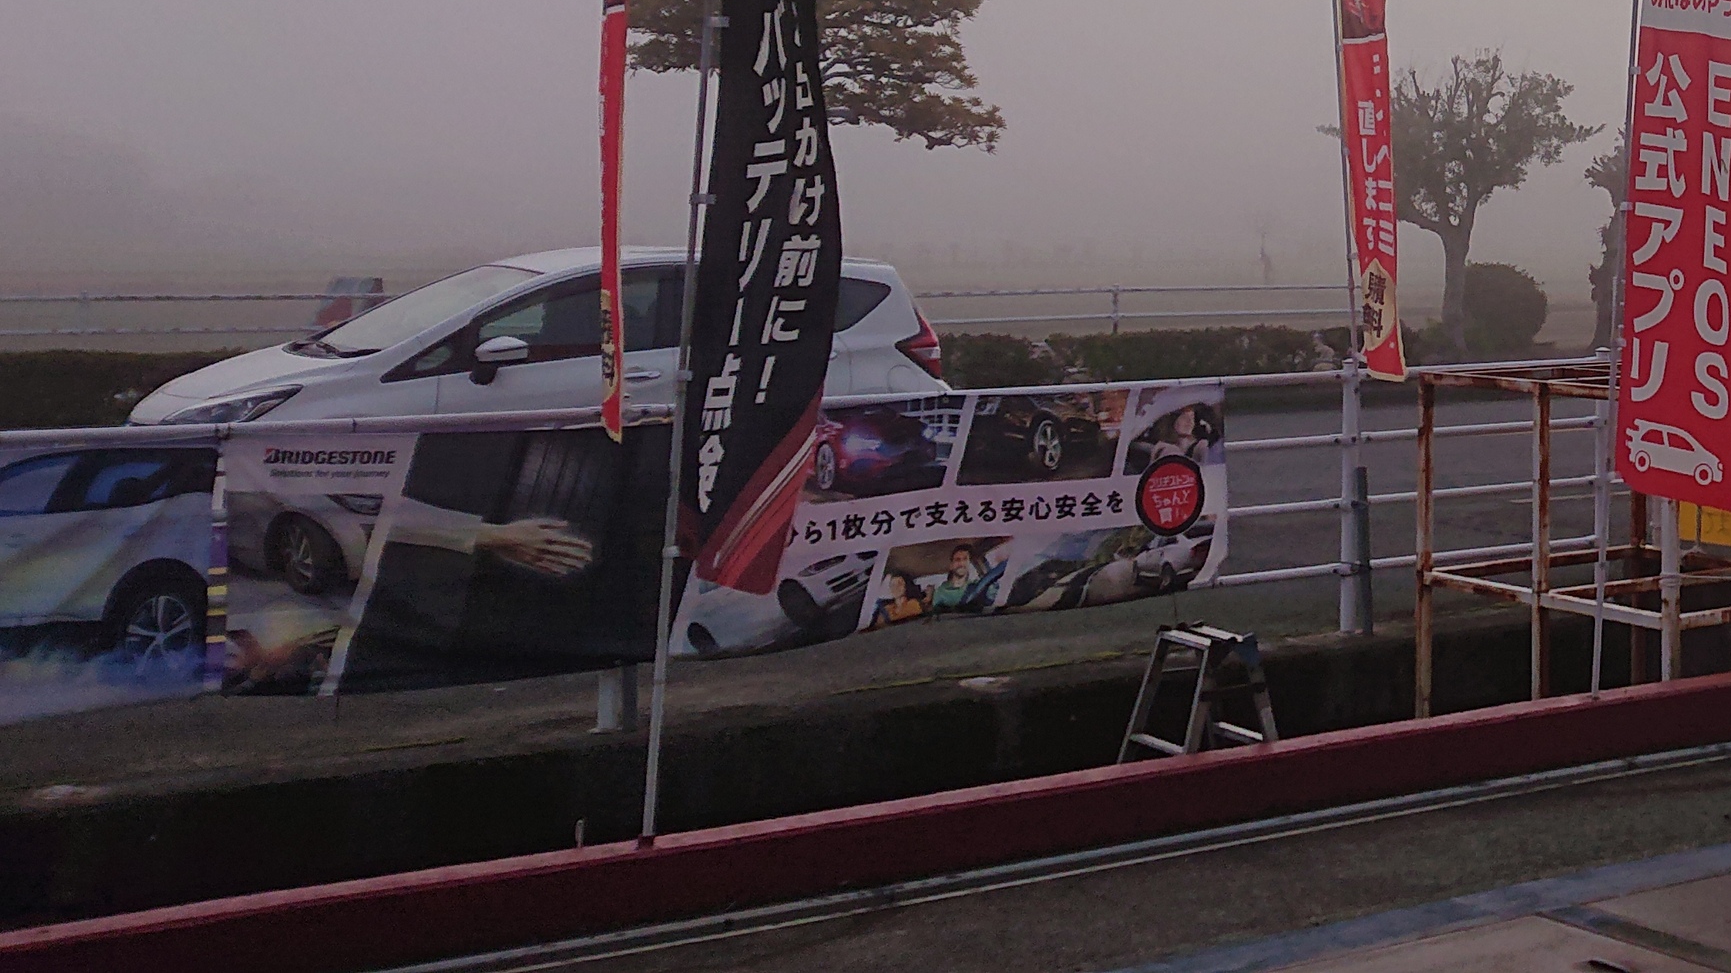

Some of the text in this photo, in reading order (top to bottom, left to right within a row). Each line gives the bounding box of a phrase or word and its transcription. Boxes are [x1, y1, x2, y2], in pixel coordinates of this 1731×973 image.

[755, 1, 826, 404] 出かけ前に!
[1357, 99, 1377, 251] 直します
[1630, 51, 1692, 402] 公式アプリ
[264, 447, 397, 464] BRIDGESTONE
